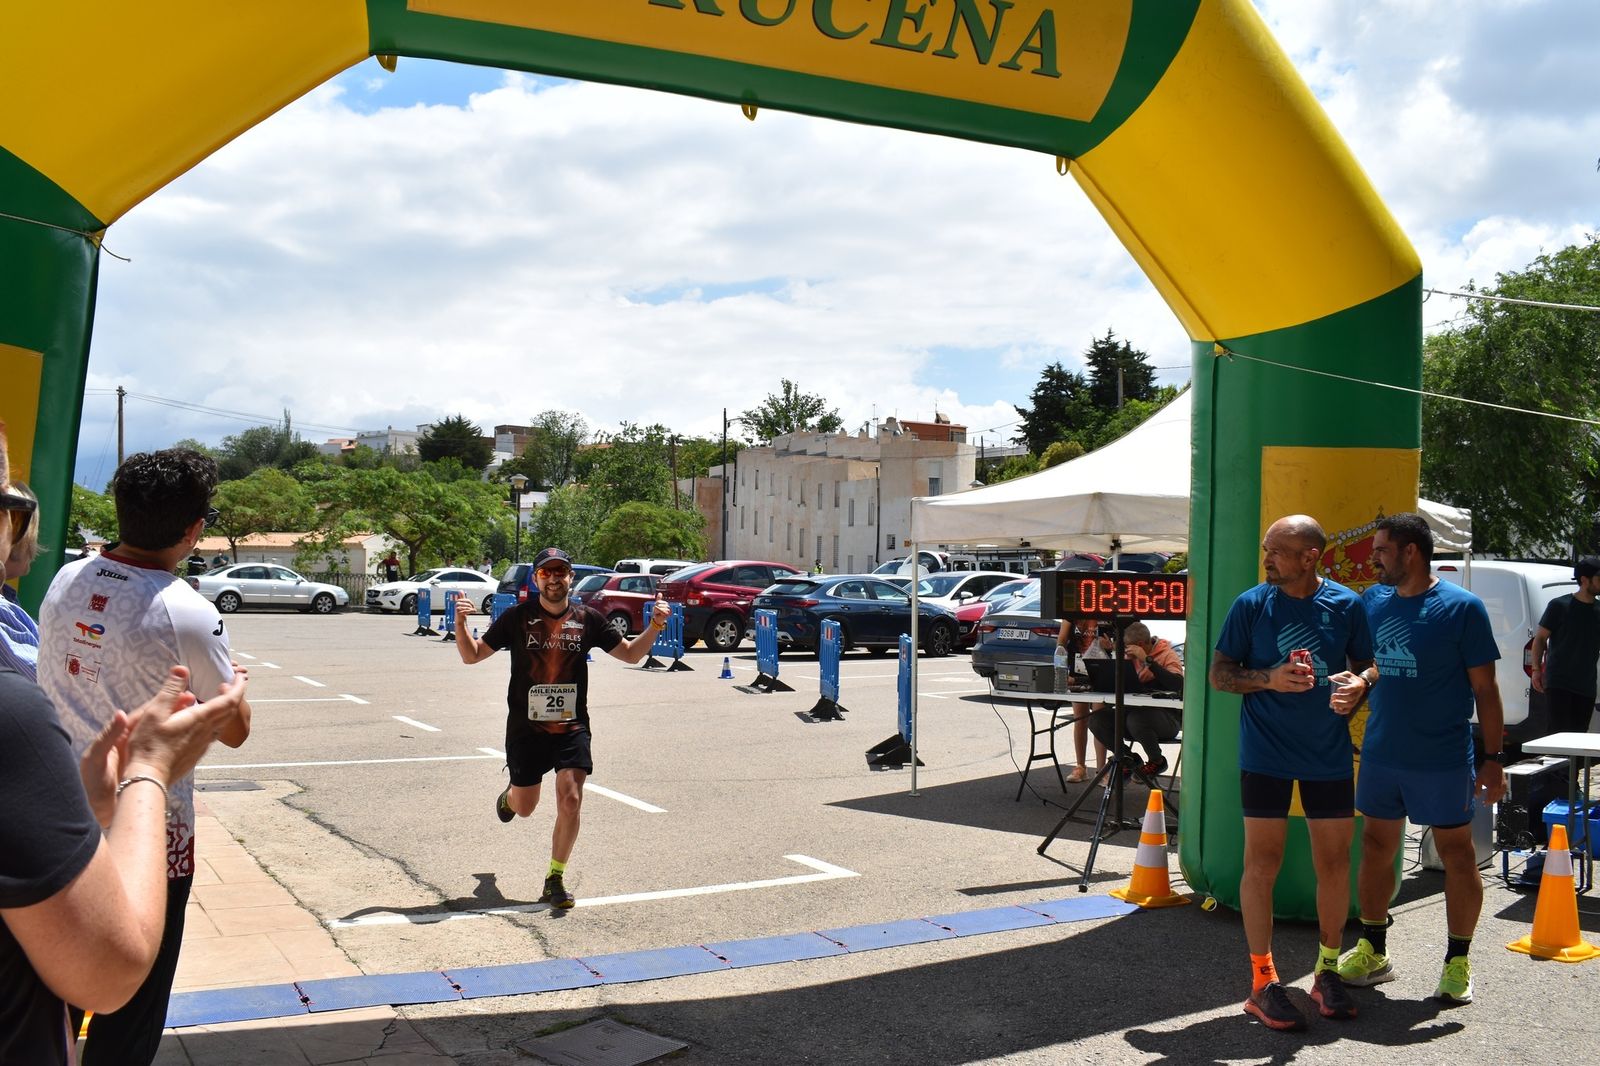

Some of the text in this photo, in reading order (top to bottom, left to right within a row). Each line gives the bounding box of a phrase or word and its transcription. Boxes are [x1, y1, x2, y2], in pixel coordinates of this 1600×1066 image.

[649, 0, 1062, 79] CENA
[1080, 579, 1184, 613] 02:36:28
[550, 633, 582, 642] MUEBLES
[1000, 629, 1014, 638] 9268
[546, 695, 565, 708] 26
